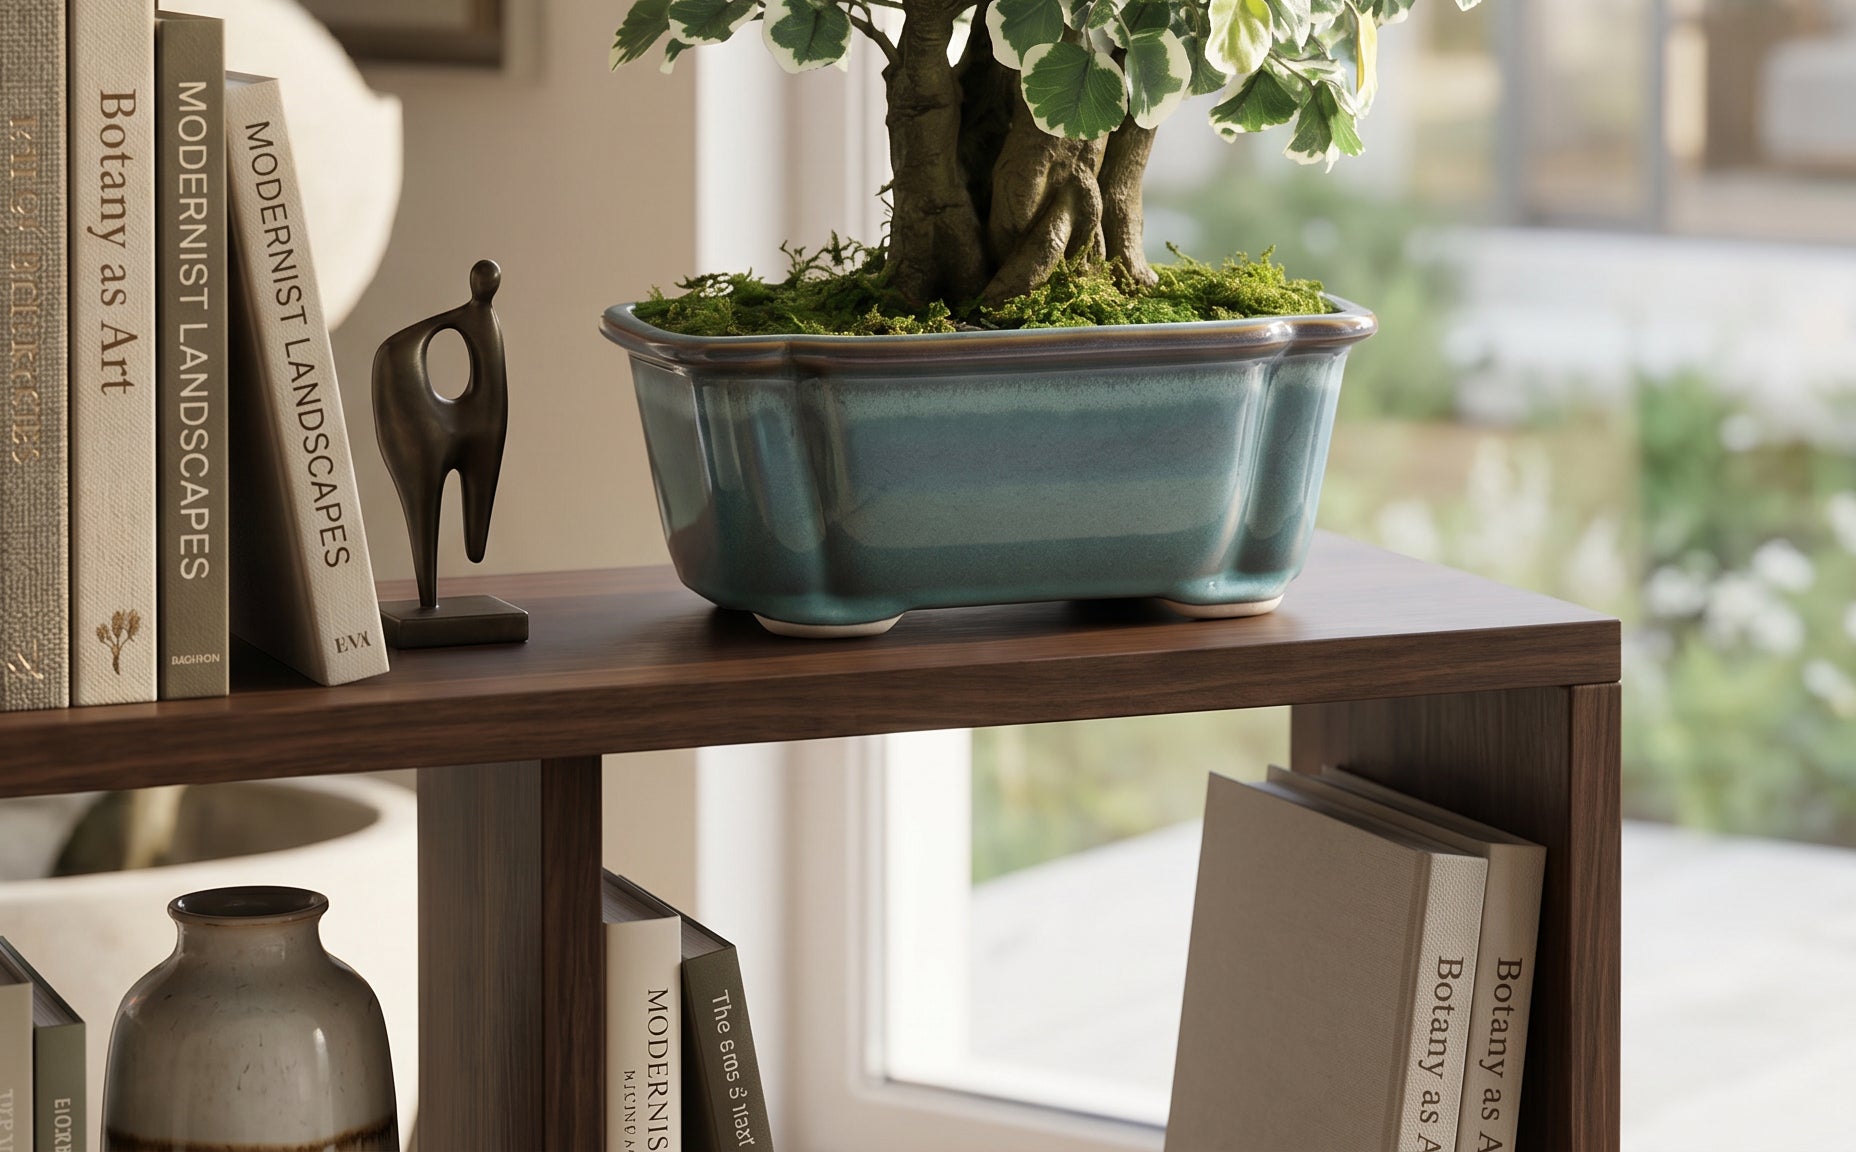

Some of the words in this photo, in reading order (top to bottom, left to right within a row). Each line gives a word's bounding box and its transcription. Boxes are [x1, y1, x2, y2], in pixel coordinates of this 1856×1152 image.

[87, 89, 137, 249] Botany
[178, 81, 208, 311] MODERNIST
[100, 263, 127, 306] as
[245, 121, 308, 327] MODERNIST
[284, 338, 350, 568] LANDSCAPES
[100, 321, 138, 396] Art
[179, 324, 209, 581] LANDSCAPES
[712, 989, 731, 1034] The
[1418, 955, 1464, 1079] Botany
[1479, 957, 1523, 1078] Botany
[1419, 1090, 1441, 1124] as
[1481, 1088, 1502, 1121] as
